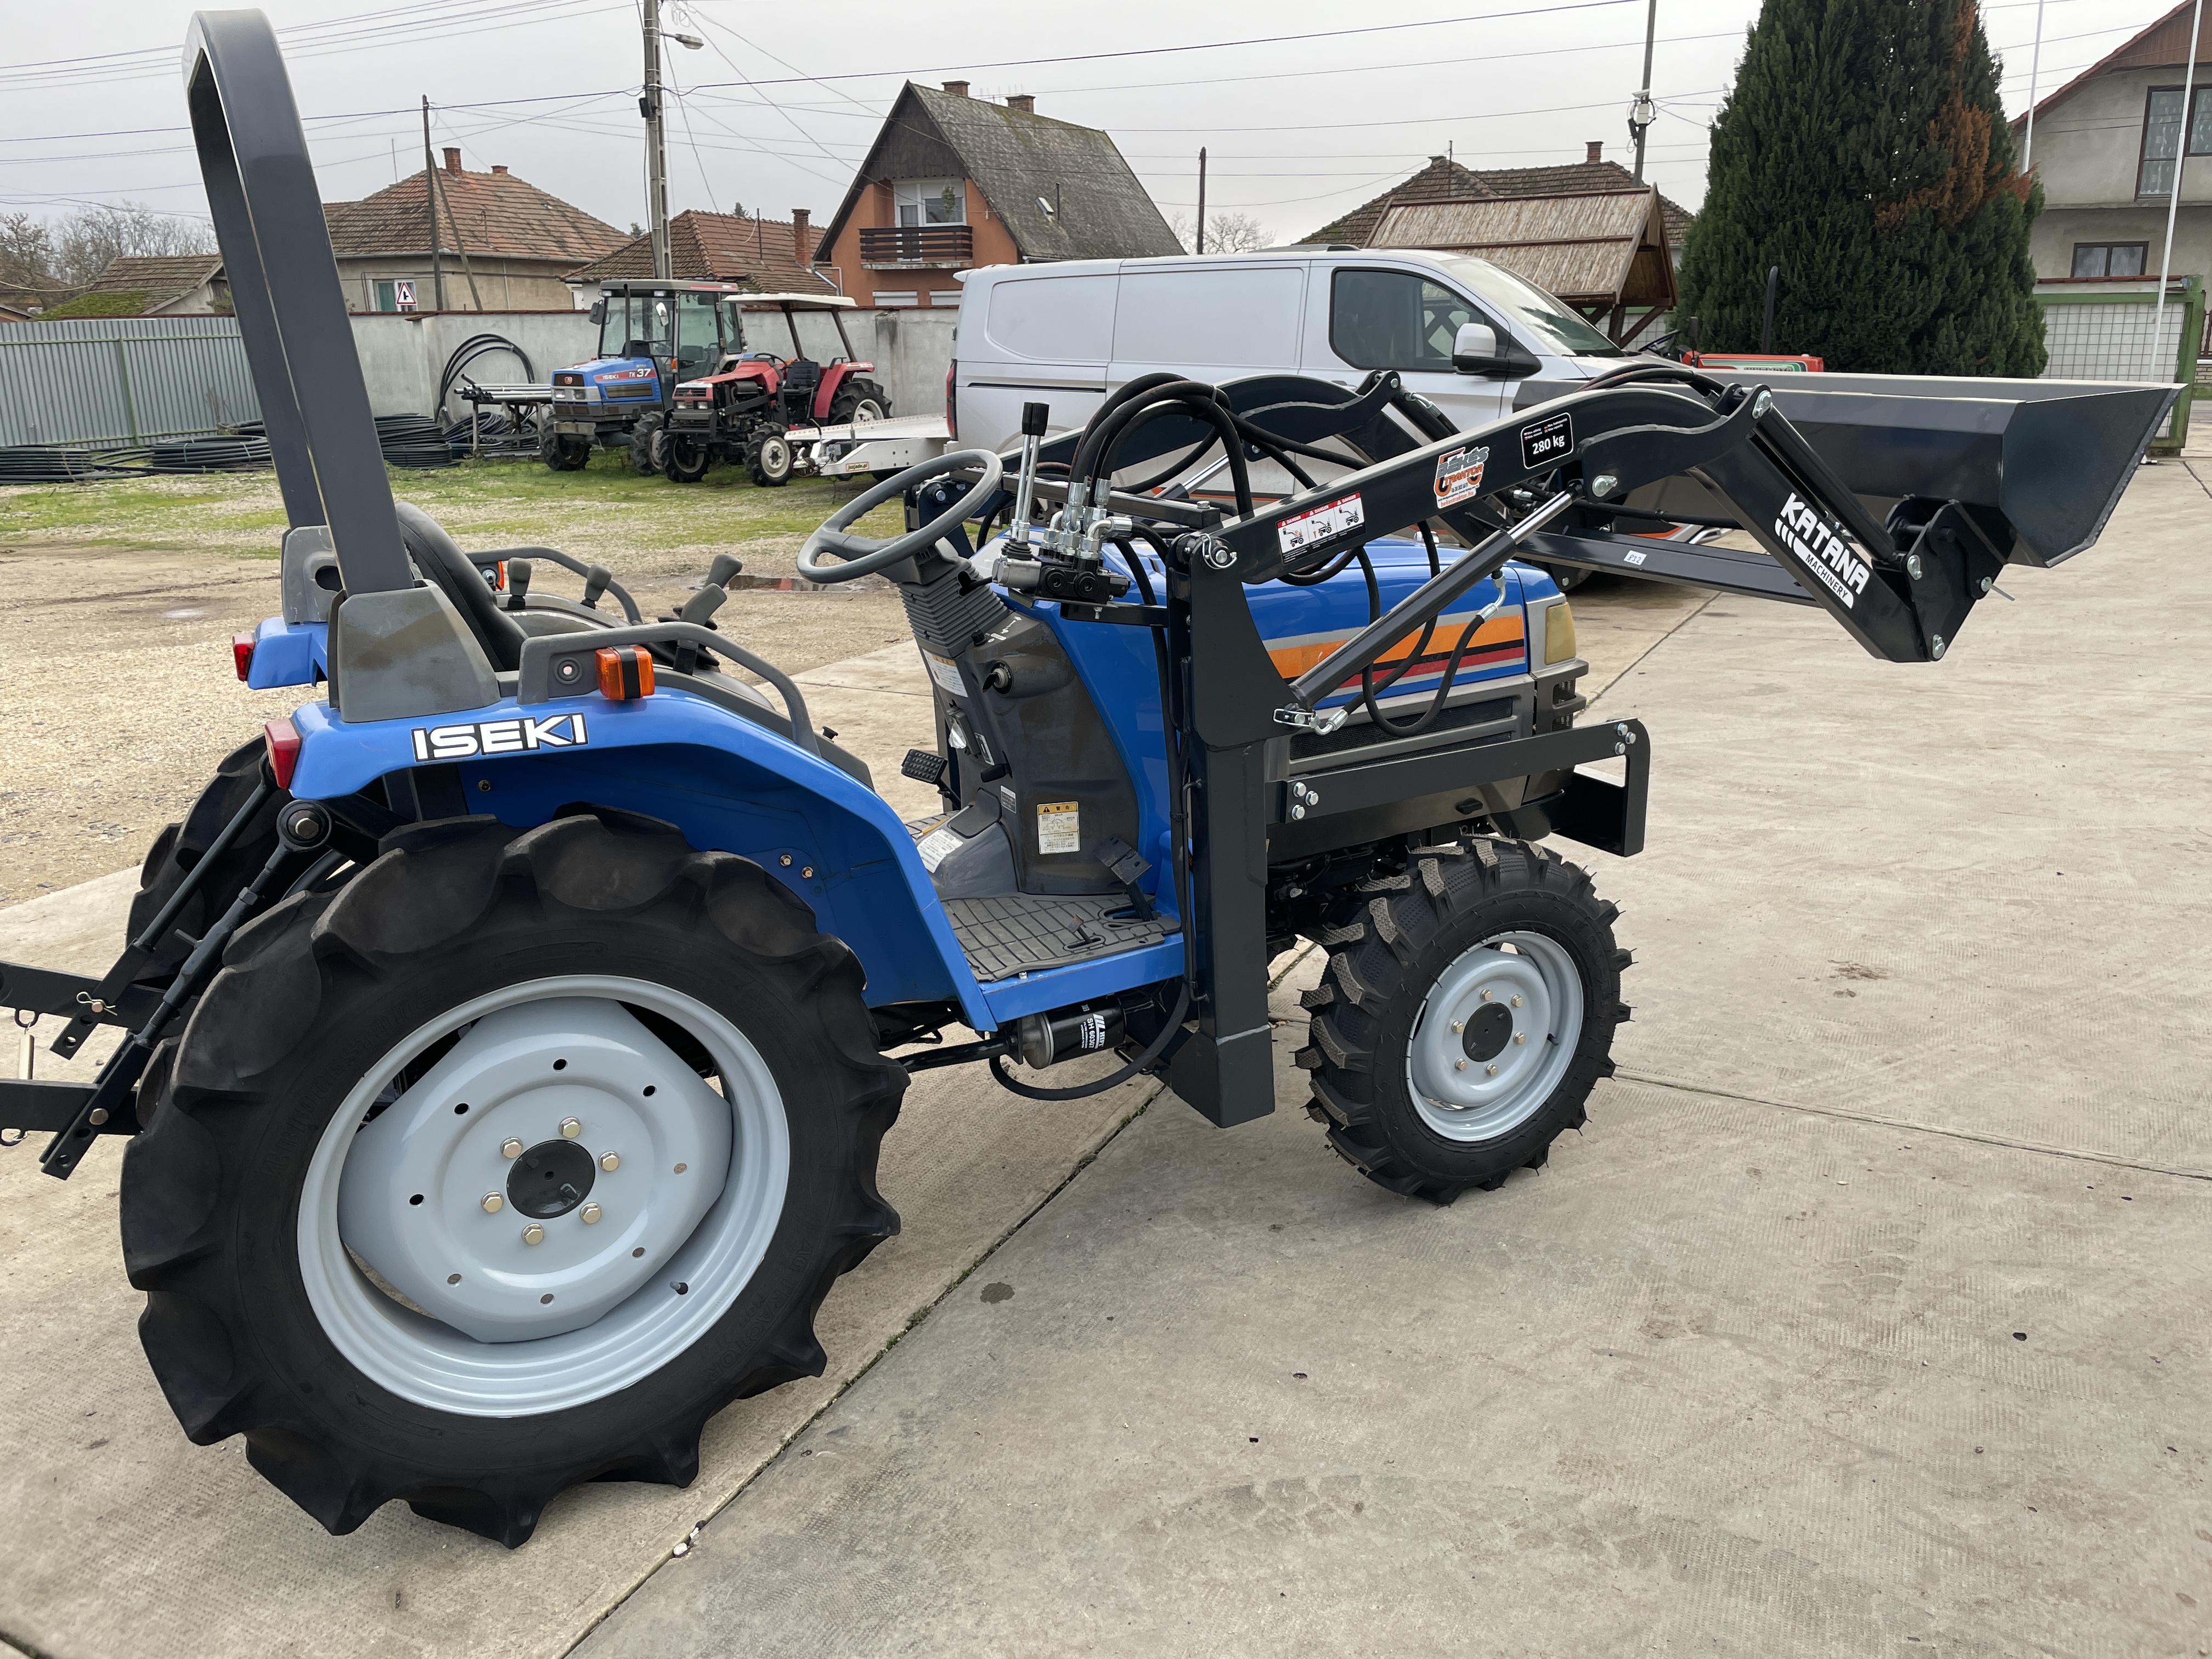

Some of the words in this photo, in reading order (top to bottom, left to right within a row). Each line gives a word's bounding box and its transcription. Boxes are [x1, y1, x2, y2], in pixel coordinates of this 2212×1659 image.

[1532, 438, 1551, 455] 280
[1553, 435, 1565, 448] kg
[1437, 447, 1489, 478] BÉKÉS
[1444, 464, 1483, 486] TRAKTOR
[1314, 505, 1329, 514] DANGER
[1780, 492, 1870, 595] KATANA
[1805, 554, 1848, 599] MACHINERY
[411, 713, 588, 761] ISEKI
[1087, 1018, 1095, 1029] SH
